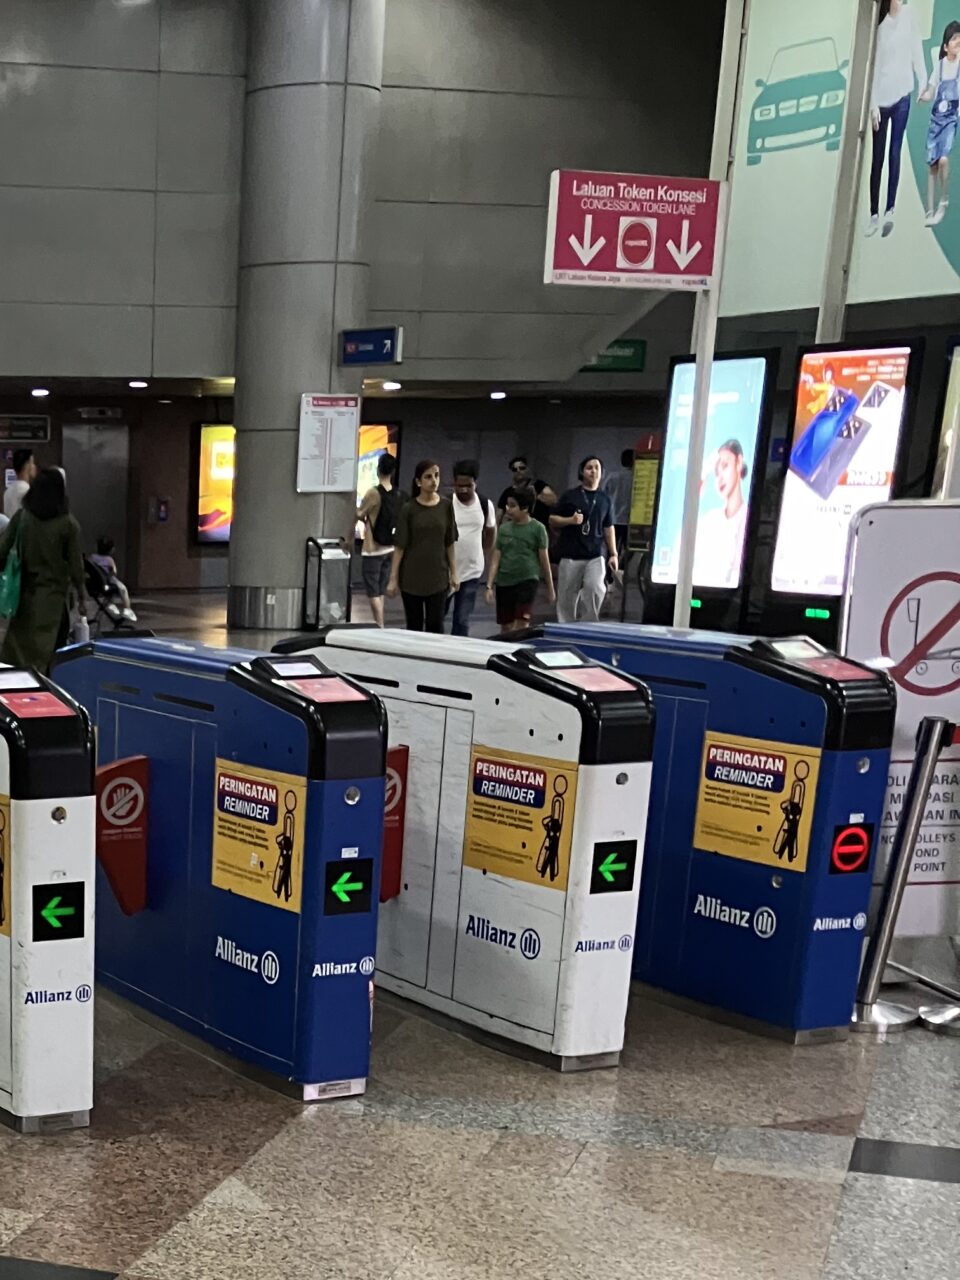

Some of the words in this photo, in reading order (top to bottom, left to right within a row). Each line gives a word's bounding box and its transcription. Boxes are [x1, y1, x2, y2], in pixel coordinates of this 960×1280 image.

[572, 179, 614, 197] Laluan
[618, 183, 654, 201] Token
[657, 185, 707, 203] Konsesi
[581, 198, 640, 212] CONCESSION
[642, 201, 672, 214] TOKEN
[673, 203, 696, 215] LANE
[709, 748, 784, 772] PERINGATAN
[476, 761, 544, 787] PERINGATAN
[714, 765, 774, 788] REMINDER
[219, 776, 277, 803] PERINGATAN
[481, 780, 535, 803] REMINDER
[224, 796, 270, 821] REMINDER
[915, 848, 940, 858] OND
[913, 862, 947, 872] POINT
[693, 894, 750, 928] Allianz
[465, 914, 516, 949] Allianz
[813, 918, 851, 931] Allianz
[215, 935, 258, 973] Allianz
[575, 940, 615, 952] Allianz
[312, 962, 357, 977] Allianz
[24, 989, 72, 1005] Allianz
